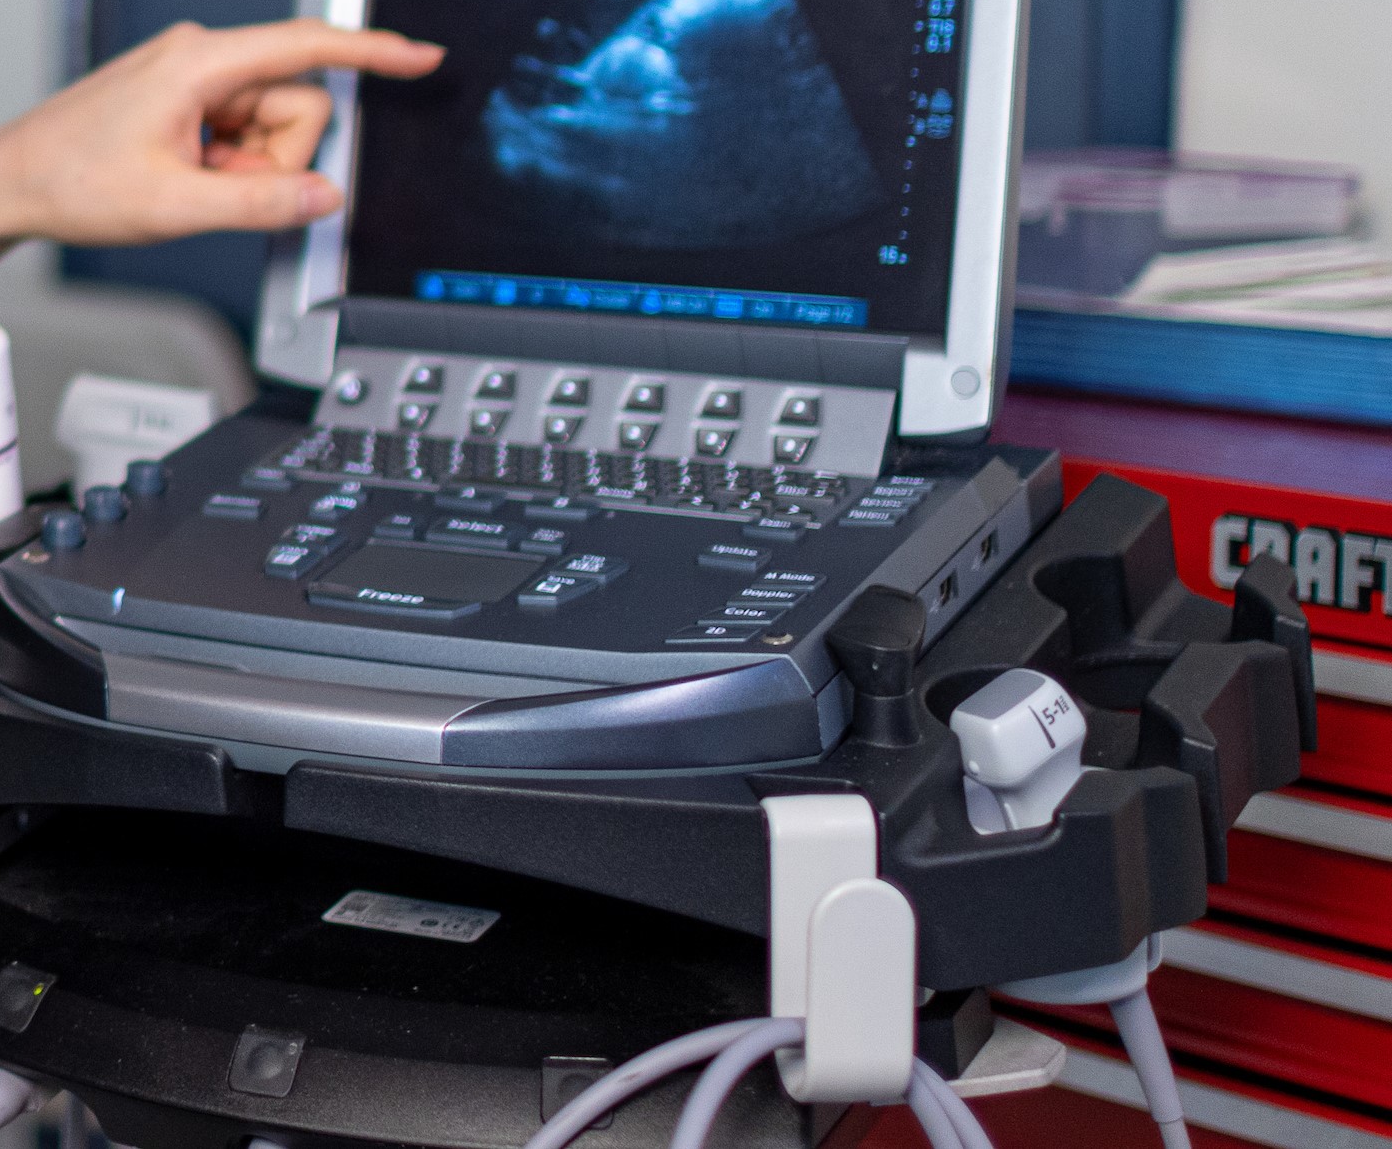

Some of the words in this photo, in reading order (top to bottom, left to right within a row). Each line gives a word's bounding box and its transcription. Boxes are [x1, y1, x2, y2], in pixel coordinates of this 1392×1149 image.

[447, 519, 505, 534] Select
[711, 544, 758, 557] Update
[764, 571, 777, 580] M
[779, 572, 815, 582] Mode
[357, 588, 425, 605] Freeze
[741, 588, 797, 600] Doppler
[724, 607, 767, 617] Color
[705, 626, 727, 635] 2D
[1041, 698, 1066, 726] 5-1
